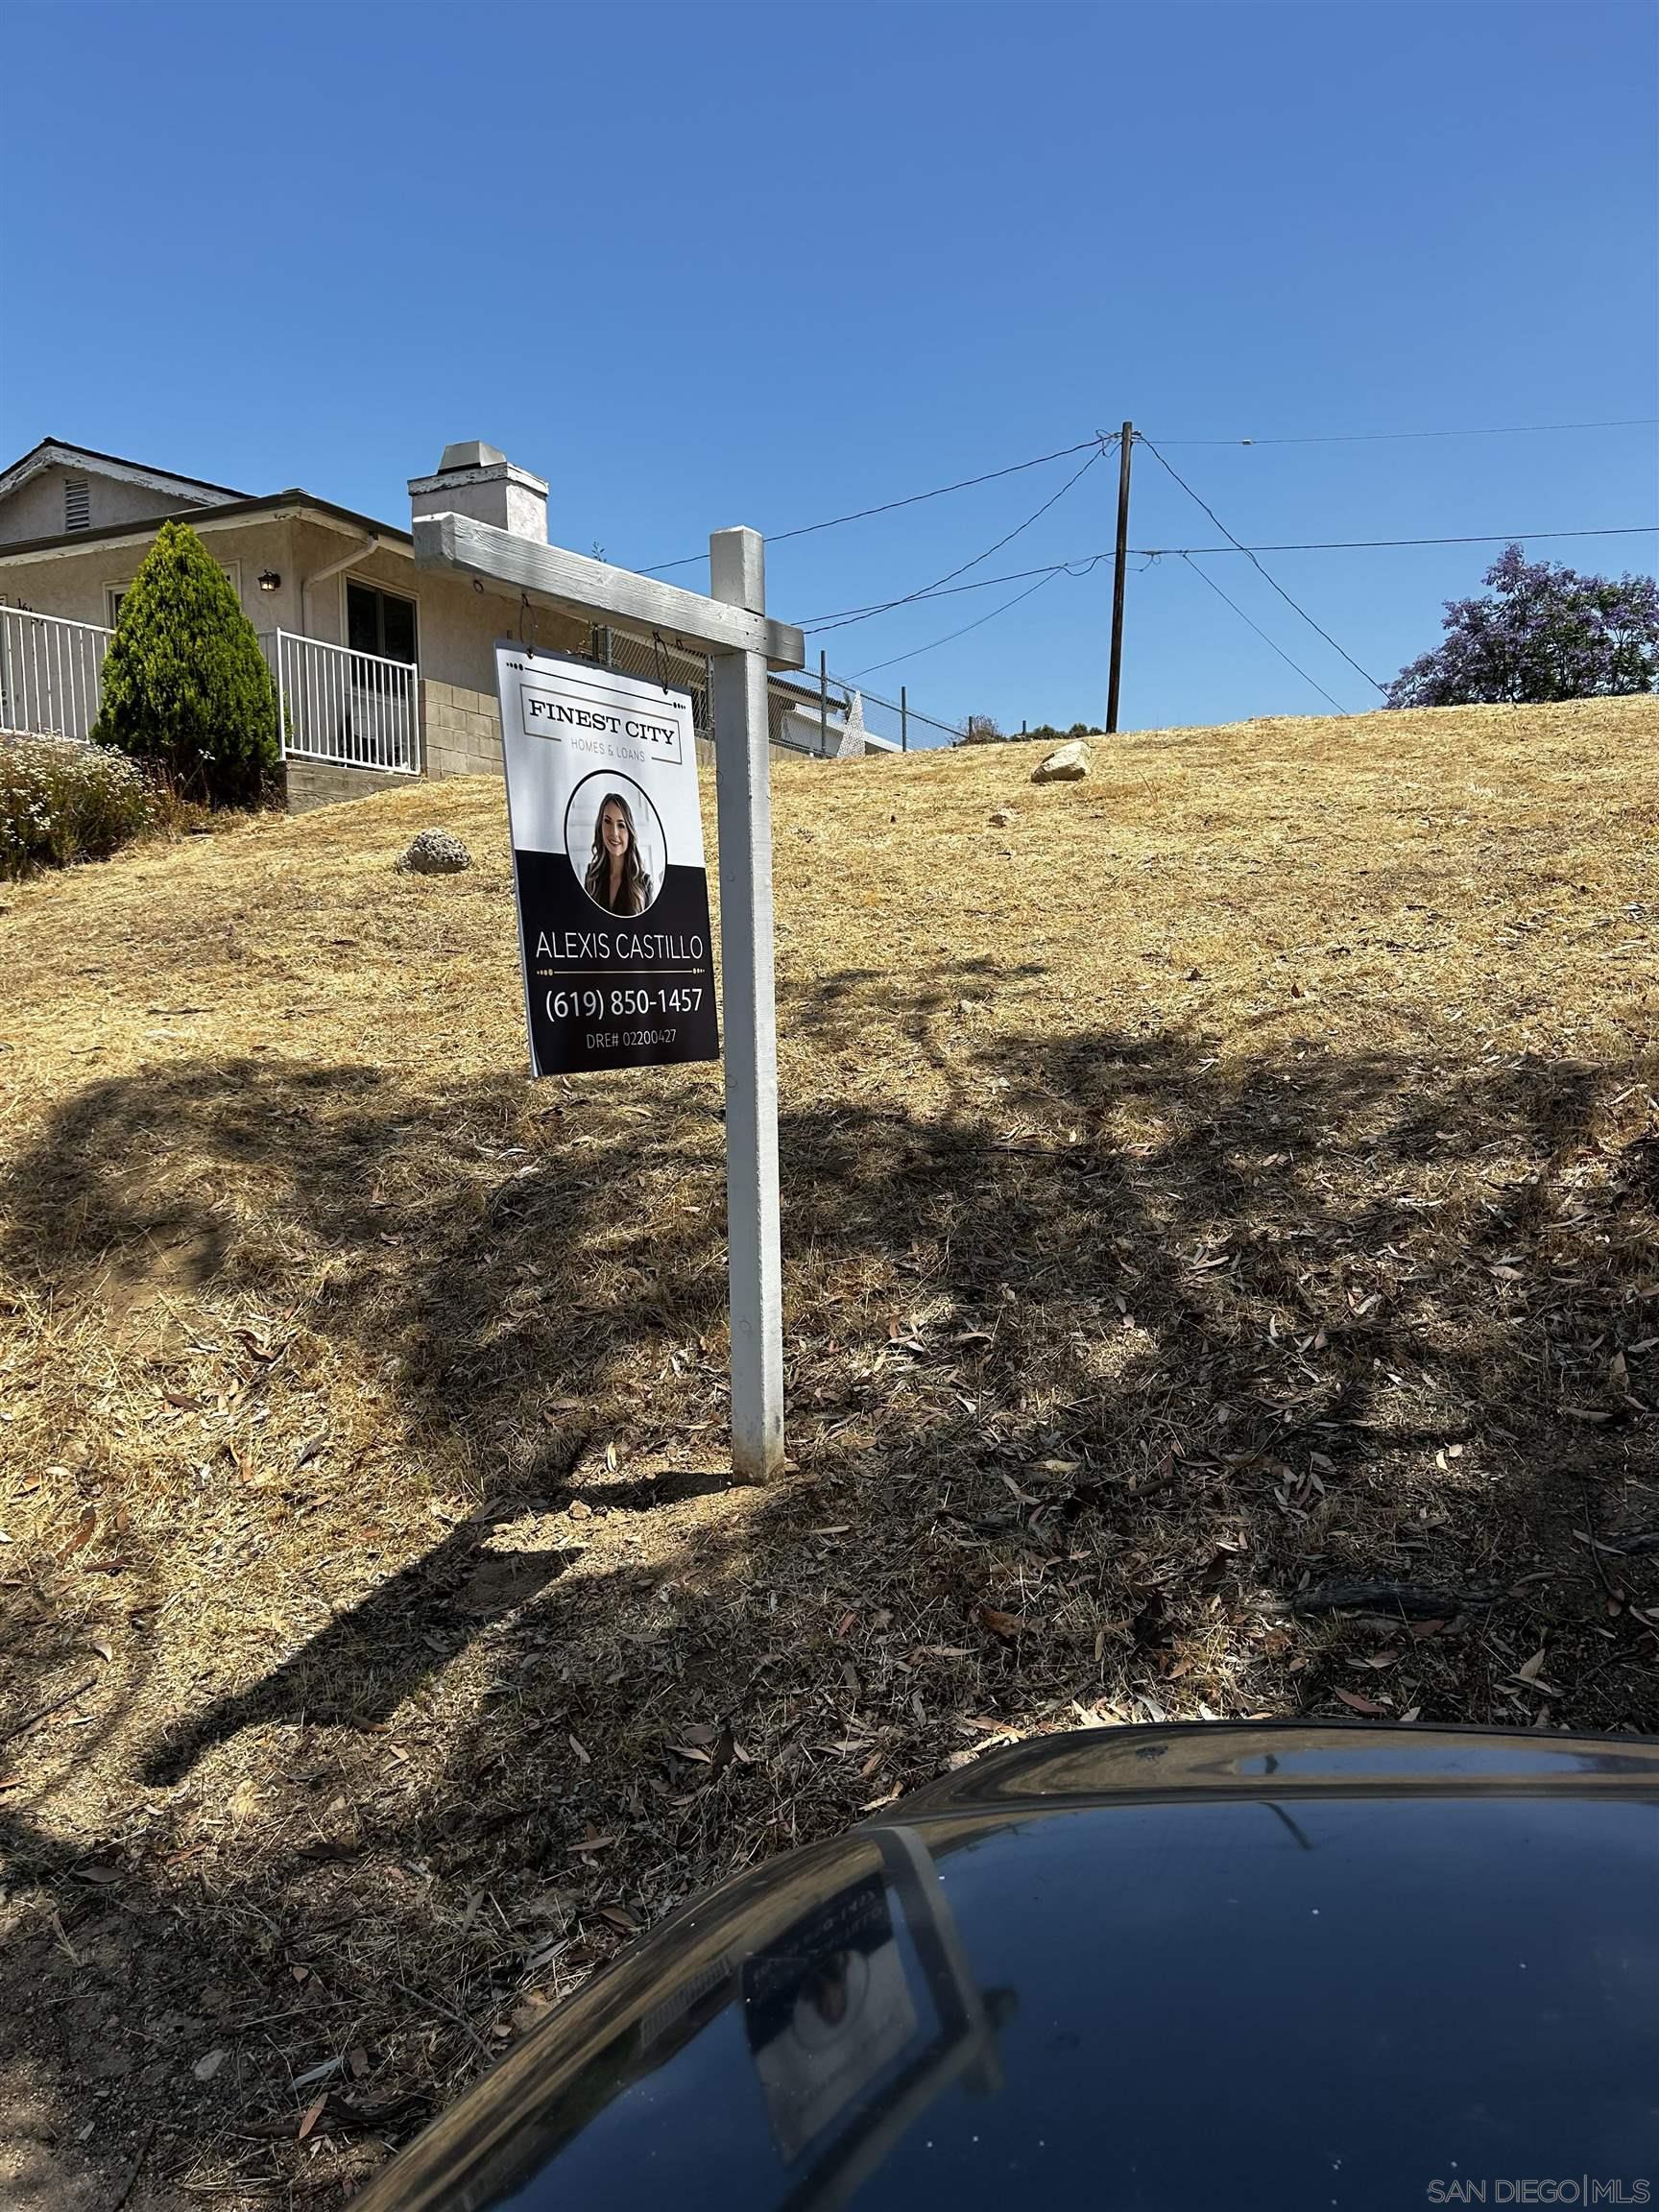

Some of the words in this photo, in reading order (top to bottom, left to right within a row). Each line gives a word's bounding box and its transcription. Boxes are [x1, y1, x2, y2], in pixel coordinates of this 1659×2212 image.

[528, 698, 621, 733] FINEST
[625, 720, 675, 746] CITY
[571, 738, 605, 756] HOMES
[609, 746, 614, 757] &
[616, 746, 646, 762] LOANS
[536, 931, 611, 959] ALEXIS
[615, 933, 704, 959] CASTILLO
[545, 989, 604, 1022] (619)
[611, 988, 703, 1016] 850-1457
[586, 1032, 619, 1049] DRE#
[623, 1028, 677, 1046] 02200427
